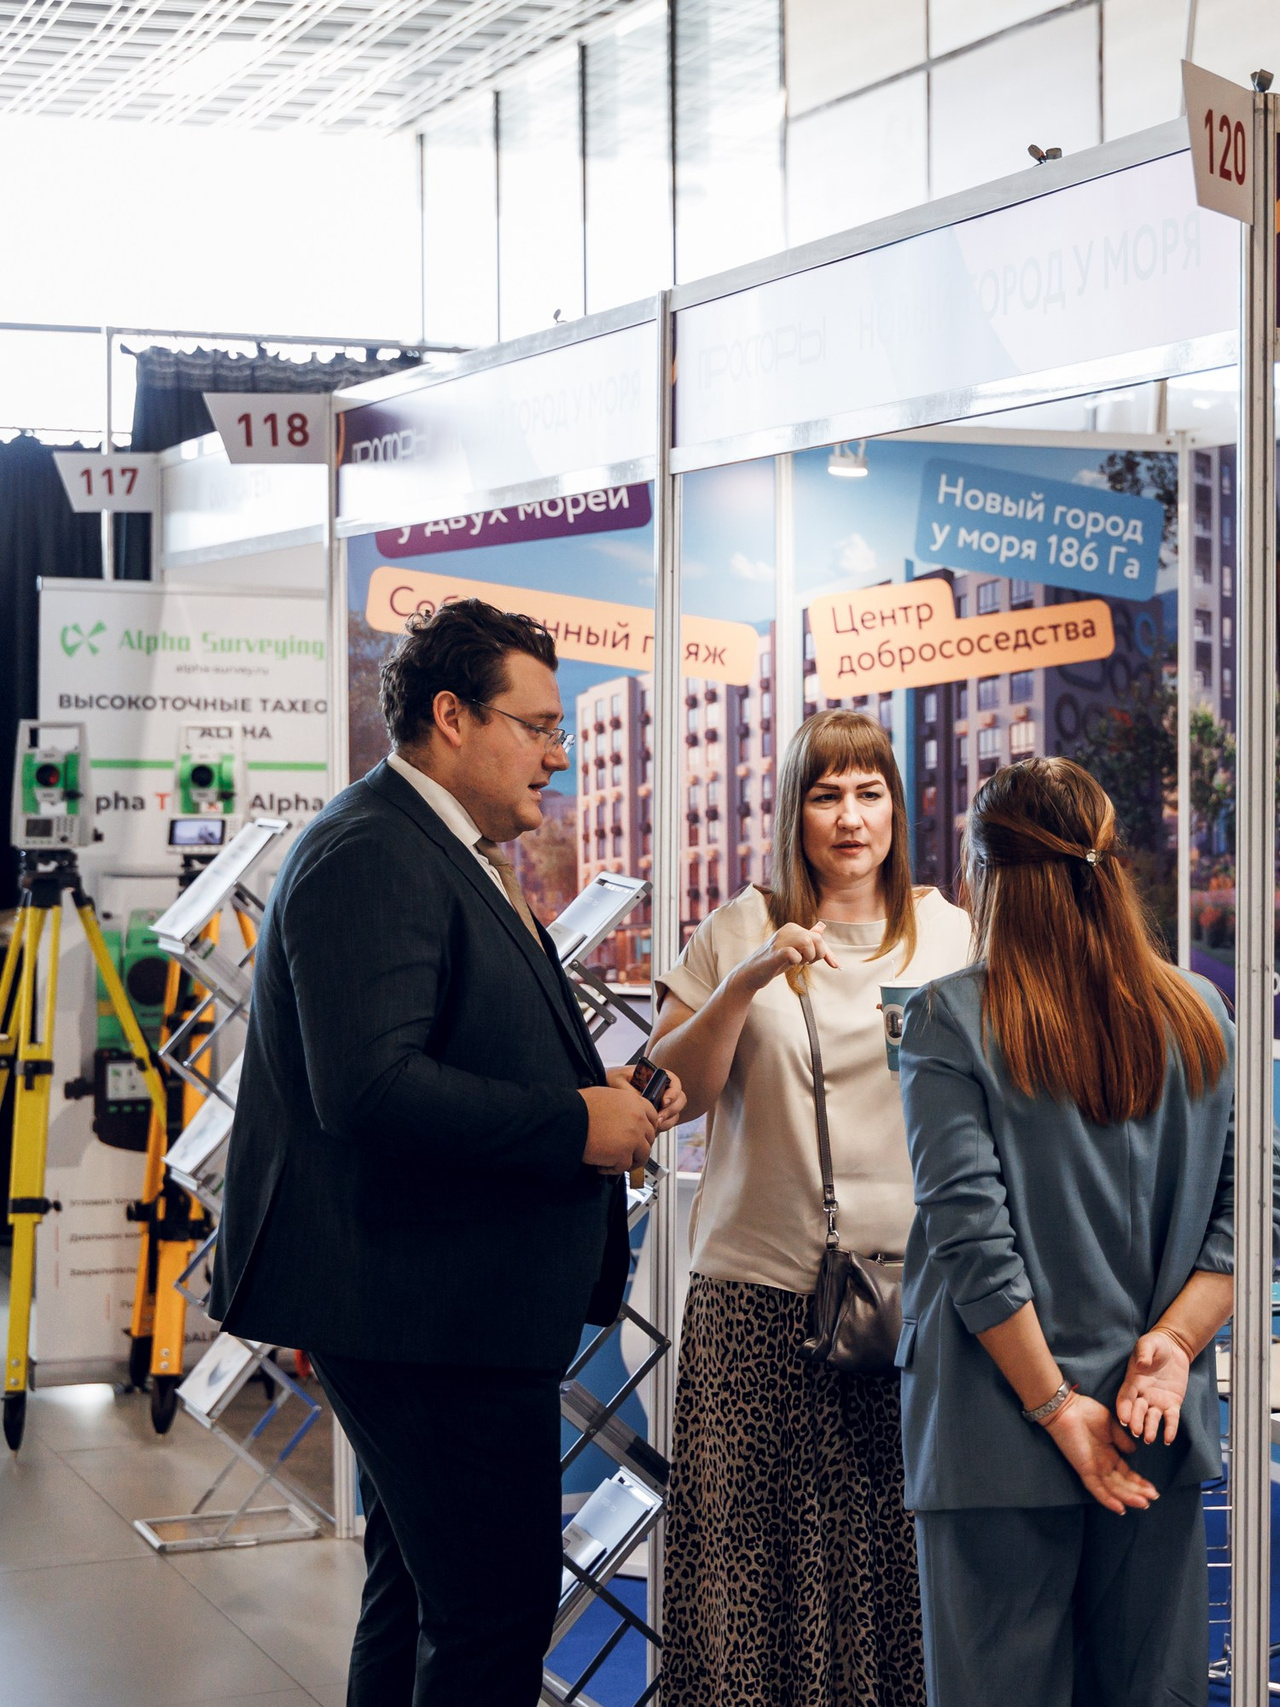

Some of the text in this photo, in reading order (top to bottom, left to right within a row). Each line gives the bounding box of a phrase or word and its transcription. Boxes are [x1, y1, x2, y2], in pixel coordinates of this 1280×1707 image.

[1203, 108, 1246, 186] 120
[237, 411, 310, 448] 118
[81, 466, 139, 496] 117
[938, 474, 1144, 545] Новый город
[929, 522, 1142, 580] у моря 186 Га
[832, 602, 934, 636] Центр
[119, 630, 325, 661] Alpha Surveying
[837, 617, 1097, 679] добрососедства
[58, 693, 253, 714] ВЫСОКОТОЧНЫЕ
[95, 791, 146, 814] pha
[250, 793, 324, 815] Alpha
